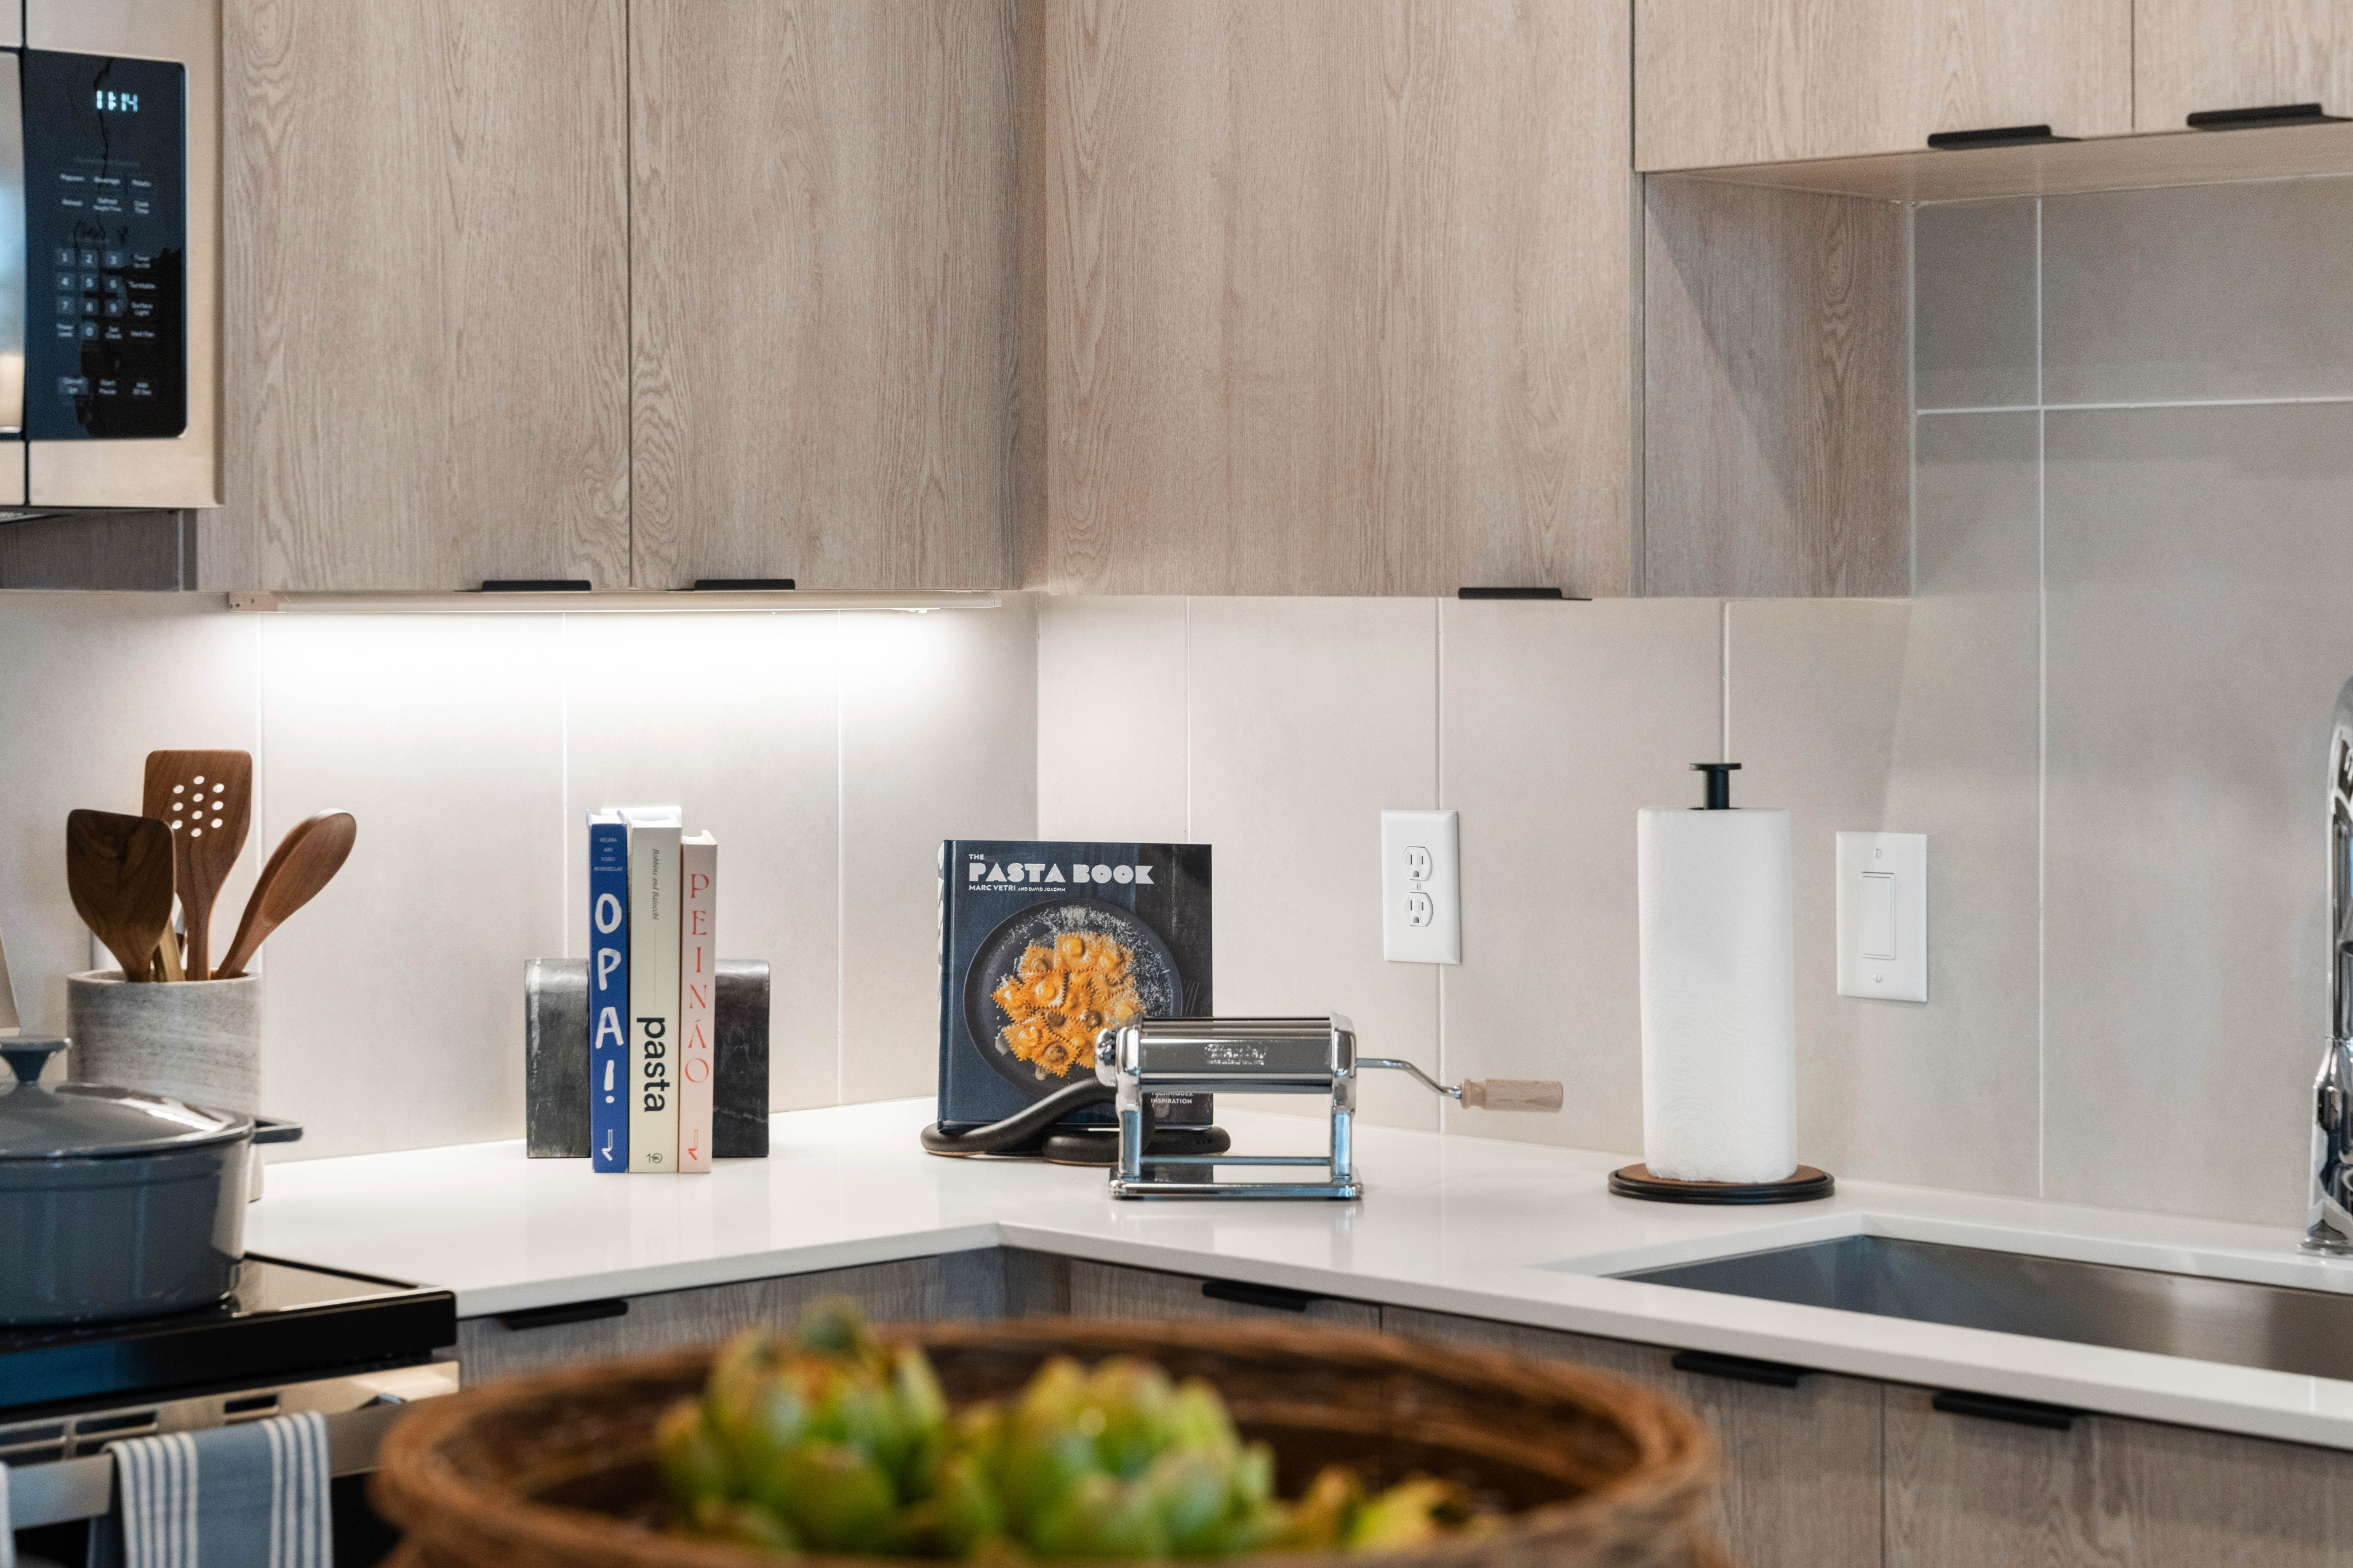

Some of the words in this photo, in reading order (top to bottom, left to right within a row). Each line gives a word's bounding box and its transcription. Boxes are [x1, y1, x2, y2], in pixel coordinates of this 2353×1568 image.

[62, 253, 68, 262] 1
[86, 254, 92, 264] 2
[110, 255, 117, 265] 3
[61, 277, 69, 286] 4
[86, 278, 93, 287] 5
[110, 279, 117, 288] 6
[62, 300, 69, 310] 7
[86, 302, 93, 312] 8
[110, 303, 117, 312] 9
[86, 326, 94, 337] 0
[969, 862, 1066, 883] PASTA
[1073, 864, 1155, 884] BOOK
[595, 893, 624, 1103] OPA!
[637, 1017, 670, 1113] pasta
